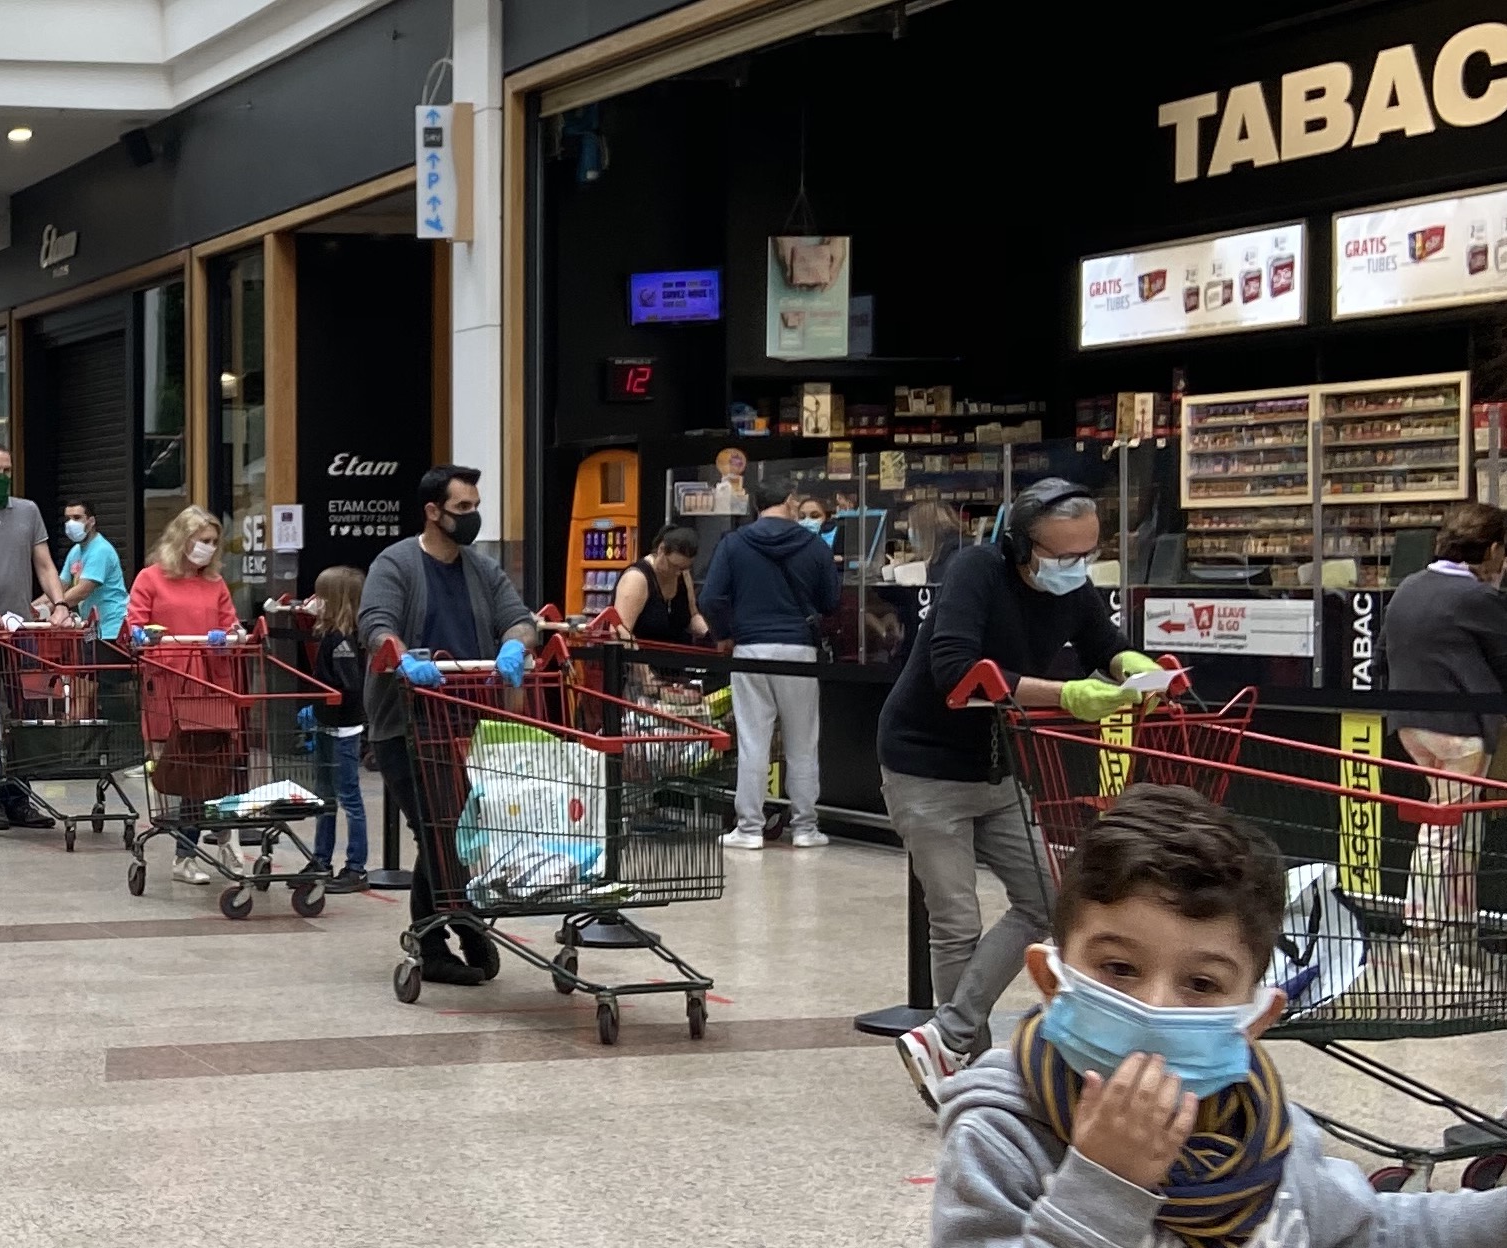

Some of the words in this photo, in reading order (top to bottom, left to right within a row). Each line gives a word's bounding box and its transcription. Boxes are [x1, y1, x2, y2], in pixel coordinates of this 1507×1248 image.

[1157, 22, 1507, 184] TABAC
[1345, 236, 1387, 257] GRATIS
[1367, 255, 1397, 273] TUBES
[1089, 278, 1121, 297] GRATIS
[626, 367, 651, 393] 12
[327, 452, 398, 476] Etam
[328, 500, 400, 513] ETAM.COM
[1217, 606, 1246, 619] LEAVE
[1226, 620, 1240, 632] GO
[1352, 592, 1373, 691] TABAC
